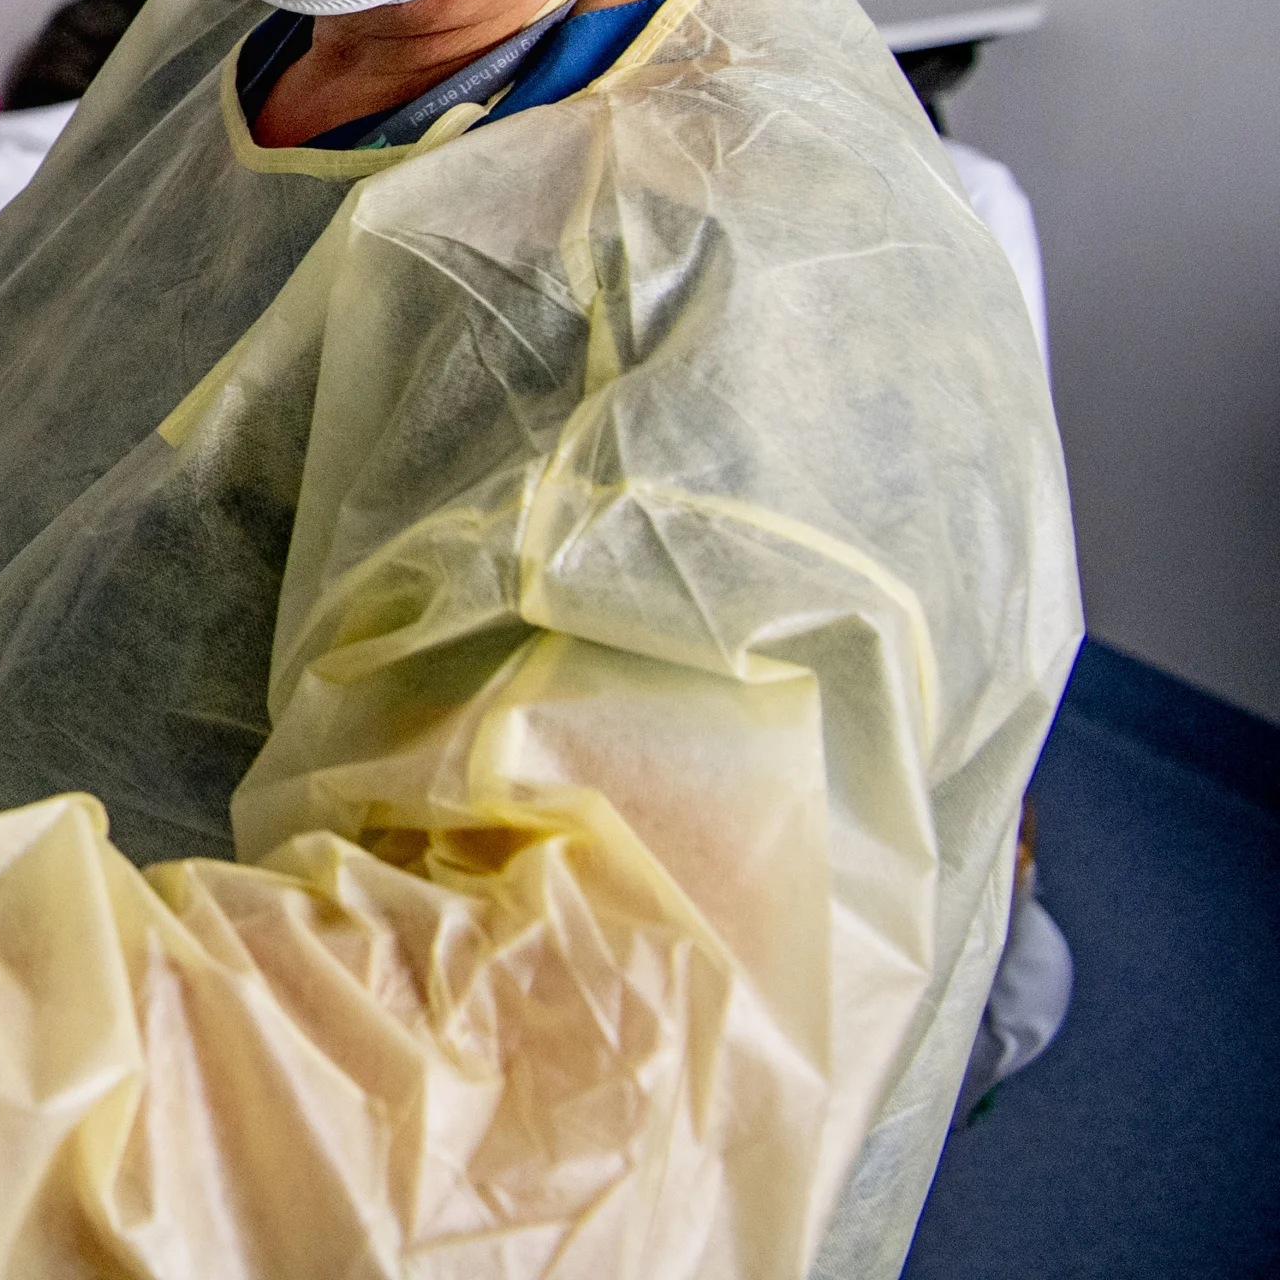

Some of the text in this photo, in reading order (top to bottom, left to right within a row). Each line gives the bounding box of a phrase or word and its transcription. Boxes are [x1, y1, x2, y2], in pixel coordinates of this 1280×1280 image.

[490, 48, 519, 75] met
[459, 68, 493, 95] hart
[437, 88, 458, 107] en
[409, 102, 438, 127] ziel
